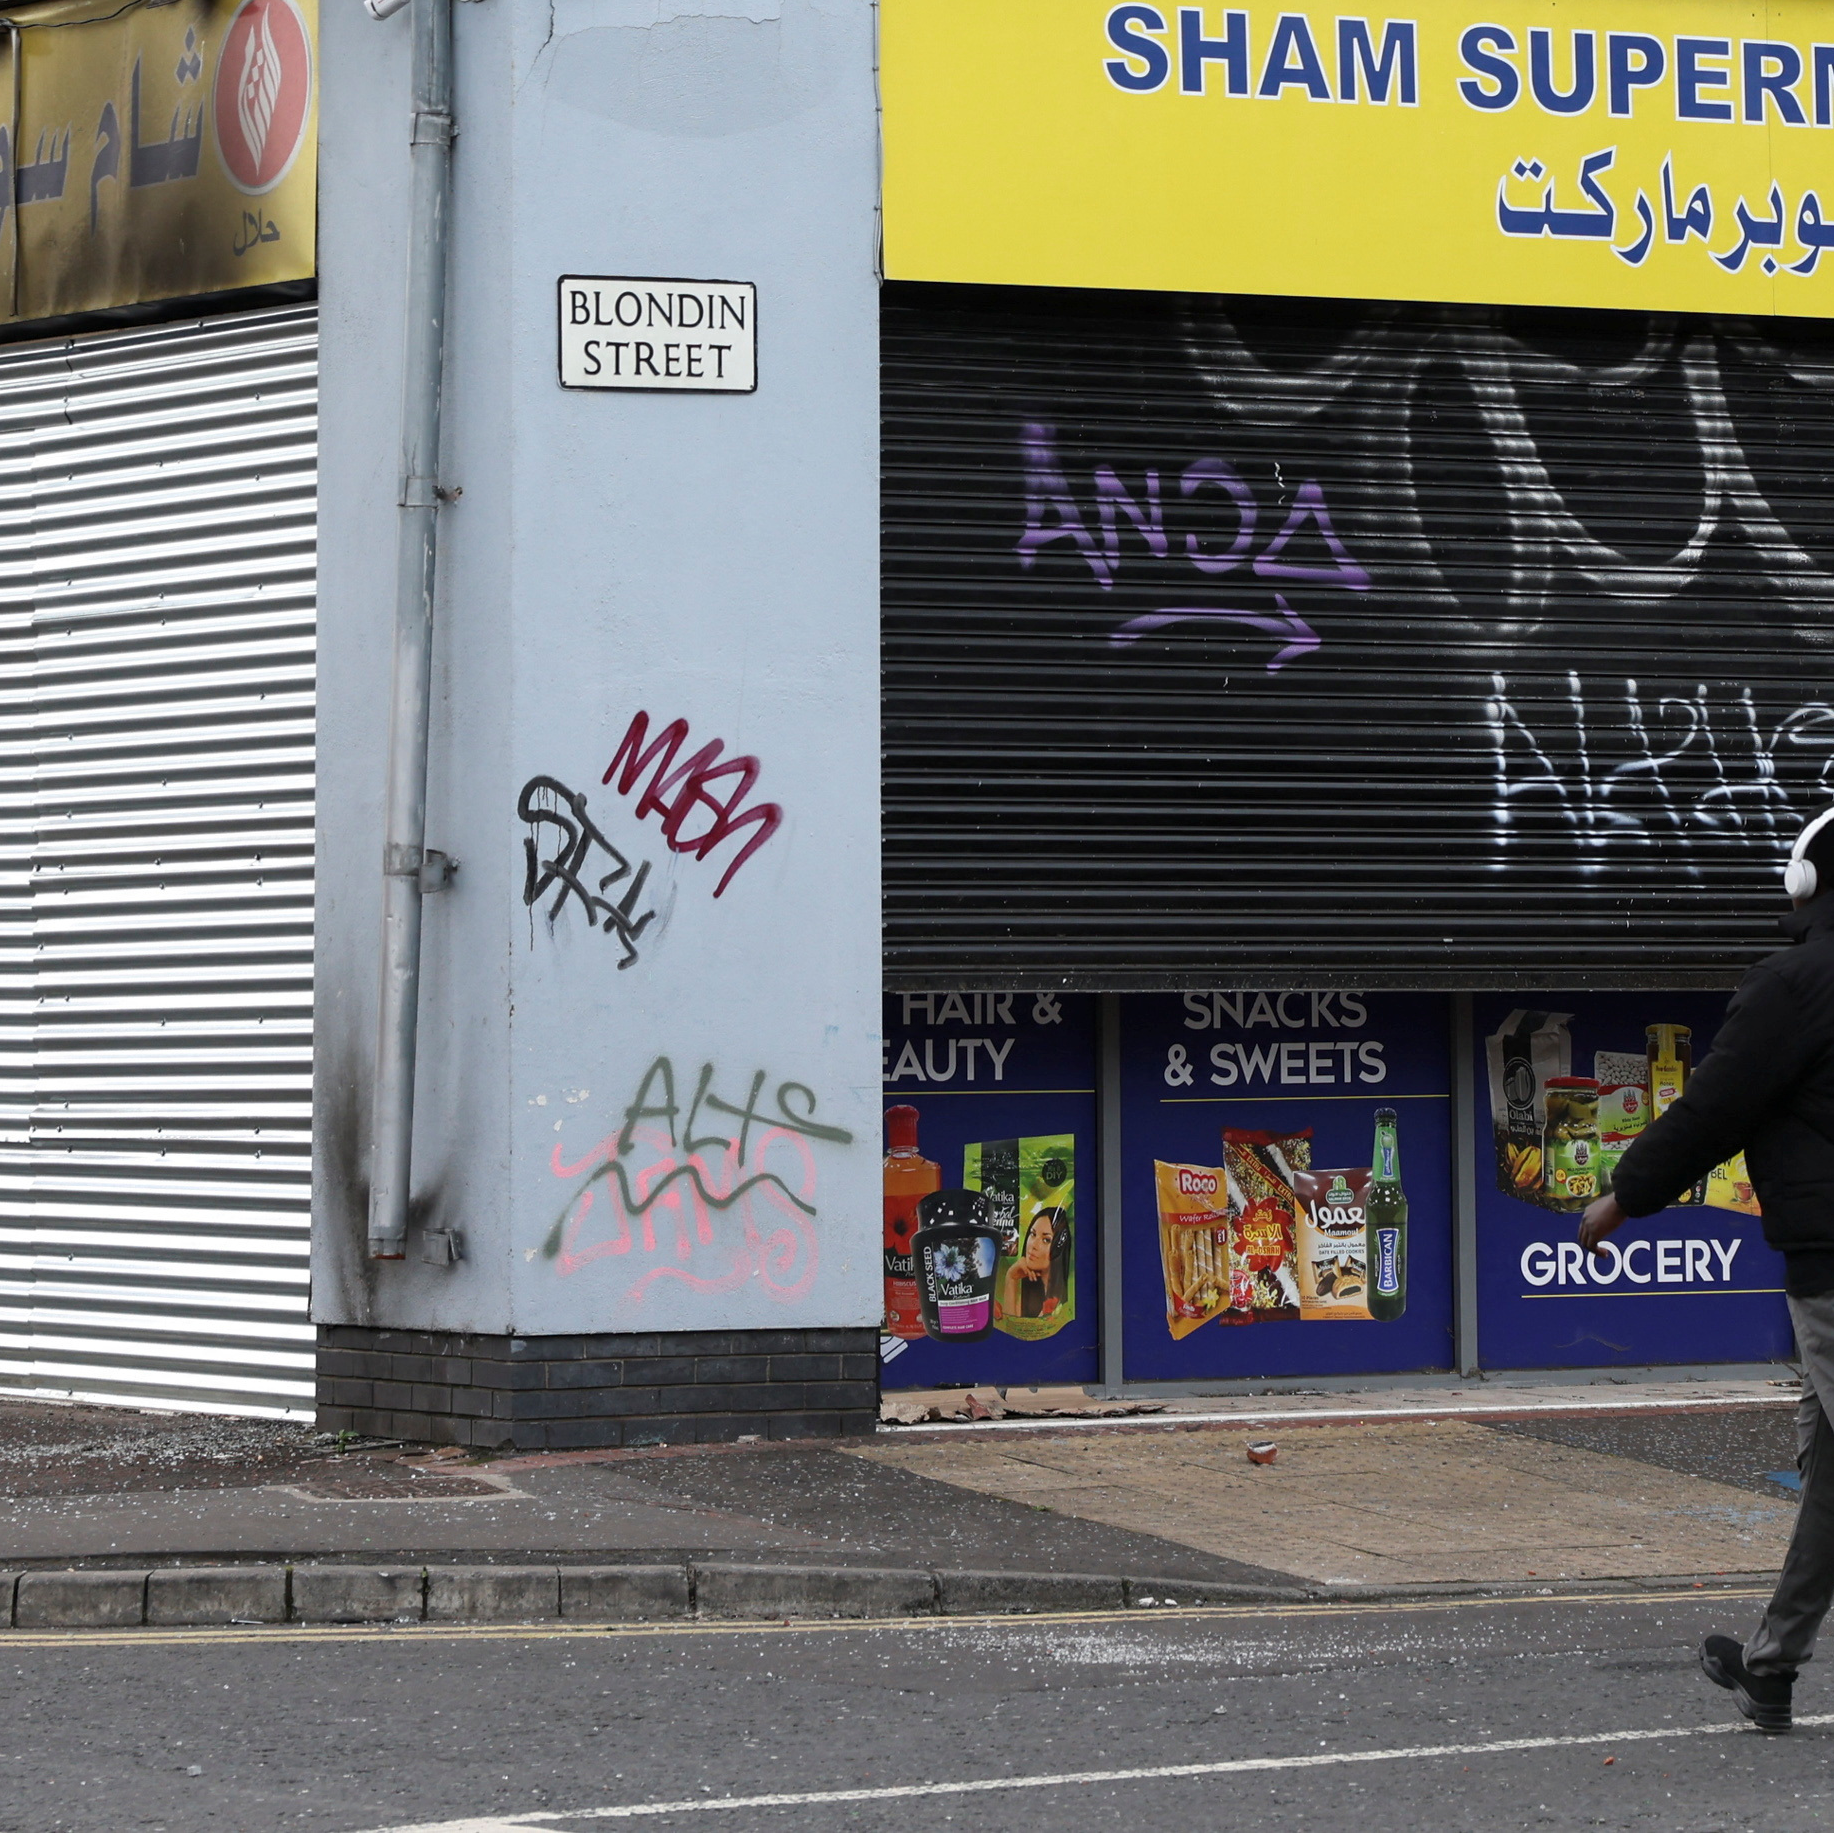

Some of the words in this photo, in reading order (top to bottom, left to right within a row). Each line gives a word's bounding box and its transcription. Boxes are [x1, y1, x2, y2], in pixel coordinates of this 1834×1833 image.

[1103, 2, 1419, 108] SHAM
[89, 24, 206, 236] شام
[233, 208, 281, 257] حلال
[570, 291, 745, 330] BLONDIN
[584, 340, 732, 378] STREET
[903, 993, 1016, 1025] HAIR
[1184, 992, 1367, 1029] SNACKS
[883, 1038, 1015, 1081] AUTY
[1164, 1044, 1194, 1087] &
[1210, 1041, 1387, 1086] SWEETS
[1710, 1168, 1727, 1180] BEL
[923, 1246, 934, 1271] SEED
[1383, 1233, 1393, 1288] BARBICAN
[1521, 1239, 1740, 1286] GROCERY
[926, 1272, 937, 1302] BLACK
[940, 1282, 973, 1296] Vatika
